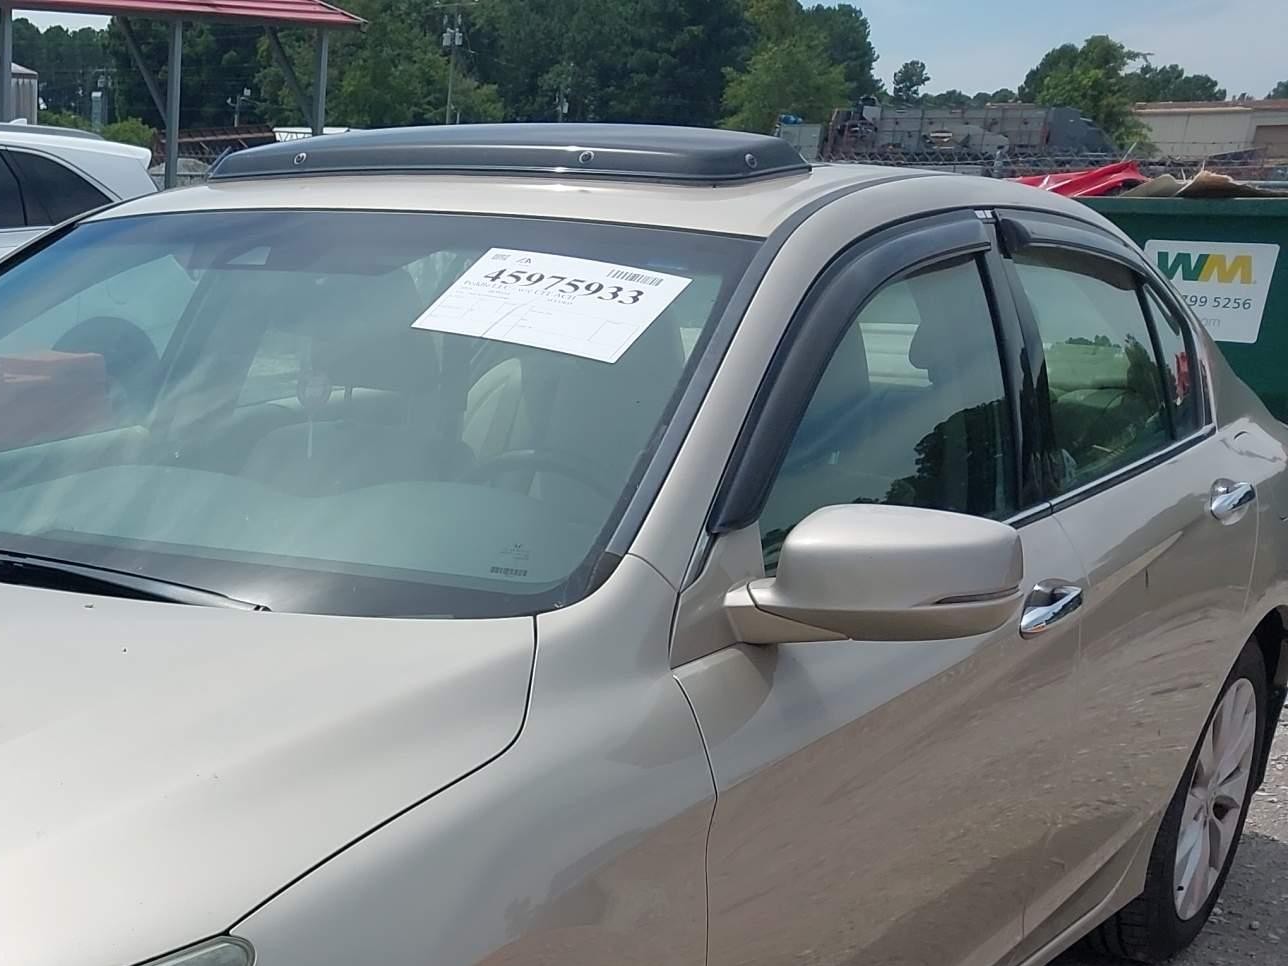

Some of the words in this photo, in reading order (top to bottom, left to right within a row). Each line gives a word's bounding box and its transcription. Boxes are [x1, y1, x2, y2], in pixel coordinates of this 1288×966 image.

[1157, 251, 1253, 284] WM
[483, 268, 645, 305] 45975933
[1212, 296, 1253, 310] 5256
